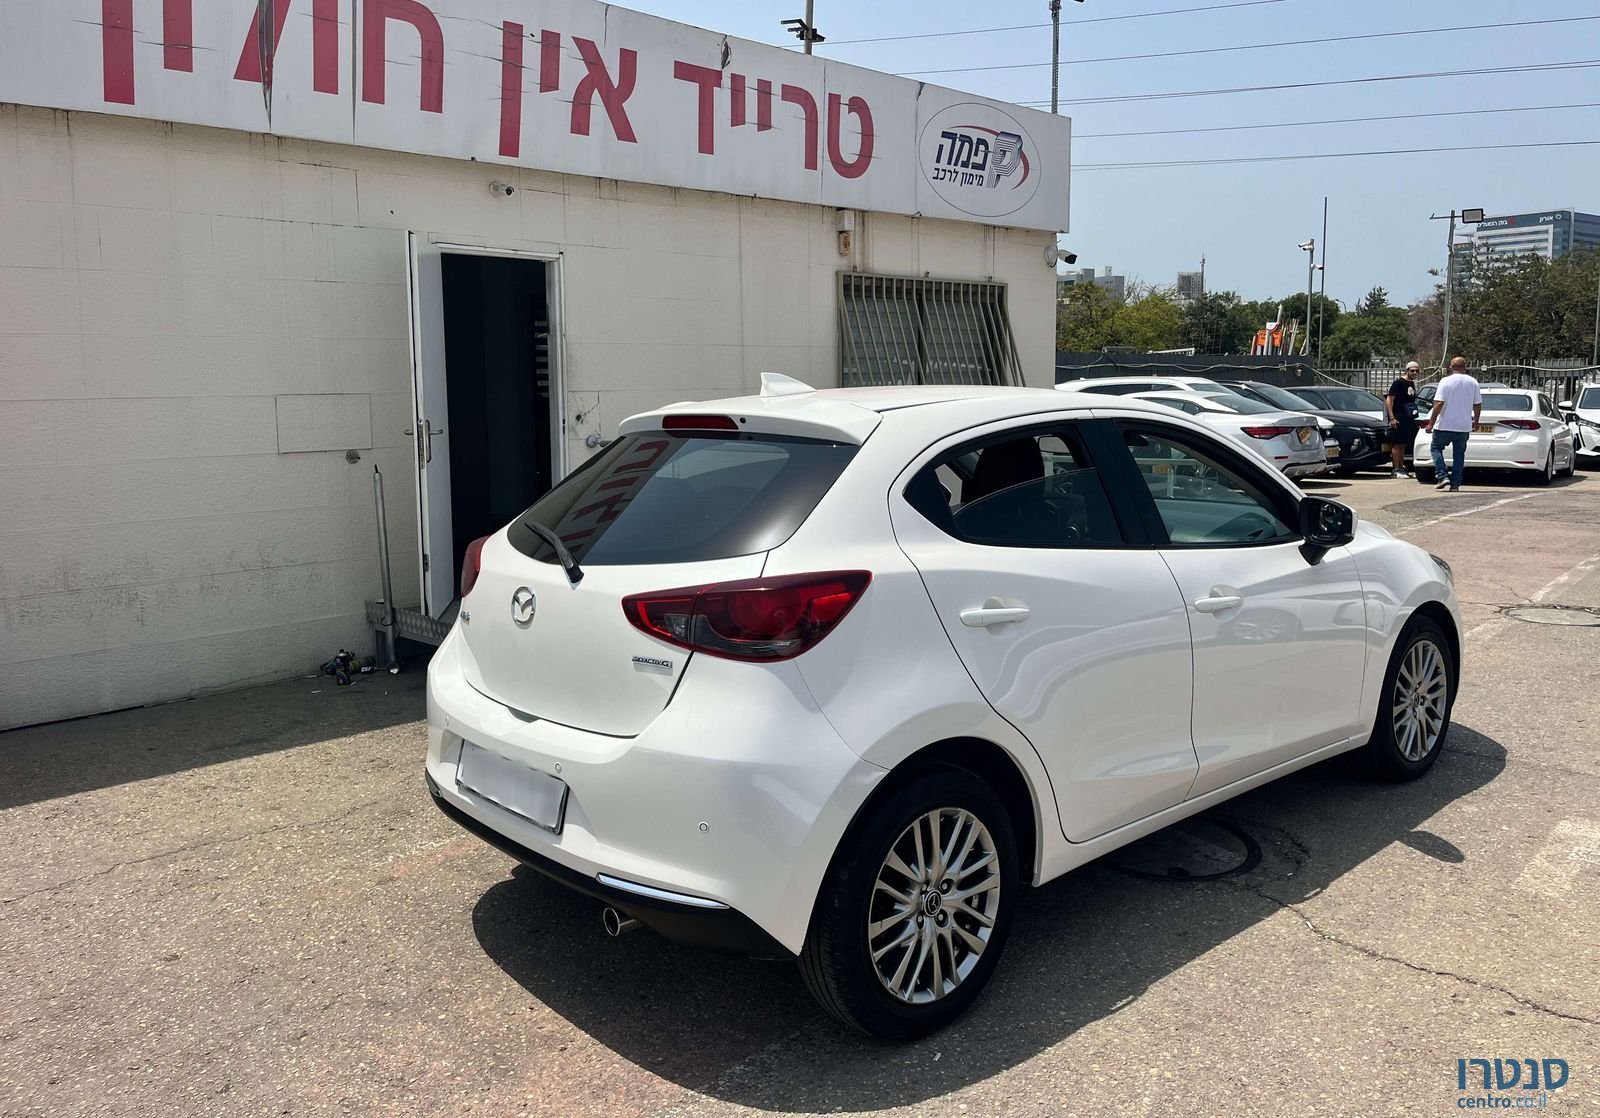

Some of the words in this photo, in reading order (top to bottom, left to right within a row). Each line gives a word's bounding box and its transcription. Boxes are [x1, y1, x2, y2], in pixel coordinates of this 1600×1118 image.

[498, 20, 639, 159] אין
[673, 59, 876, 180] טרייד
[935, 130, 990, 172] פמה
[932, 167, 959, 183] לרכב
[960, 171, 985, 187] מימון
